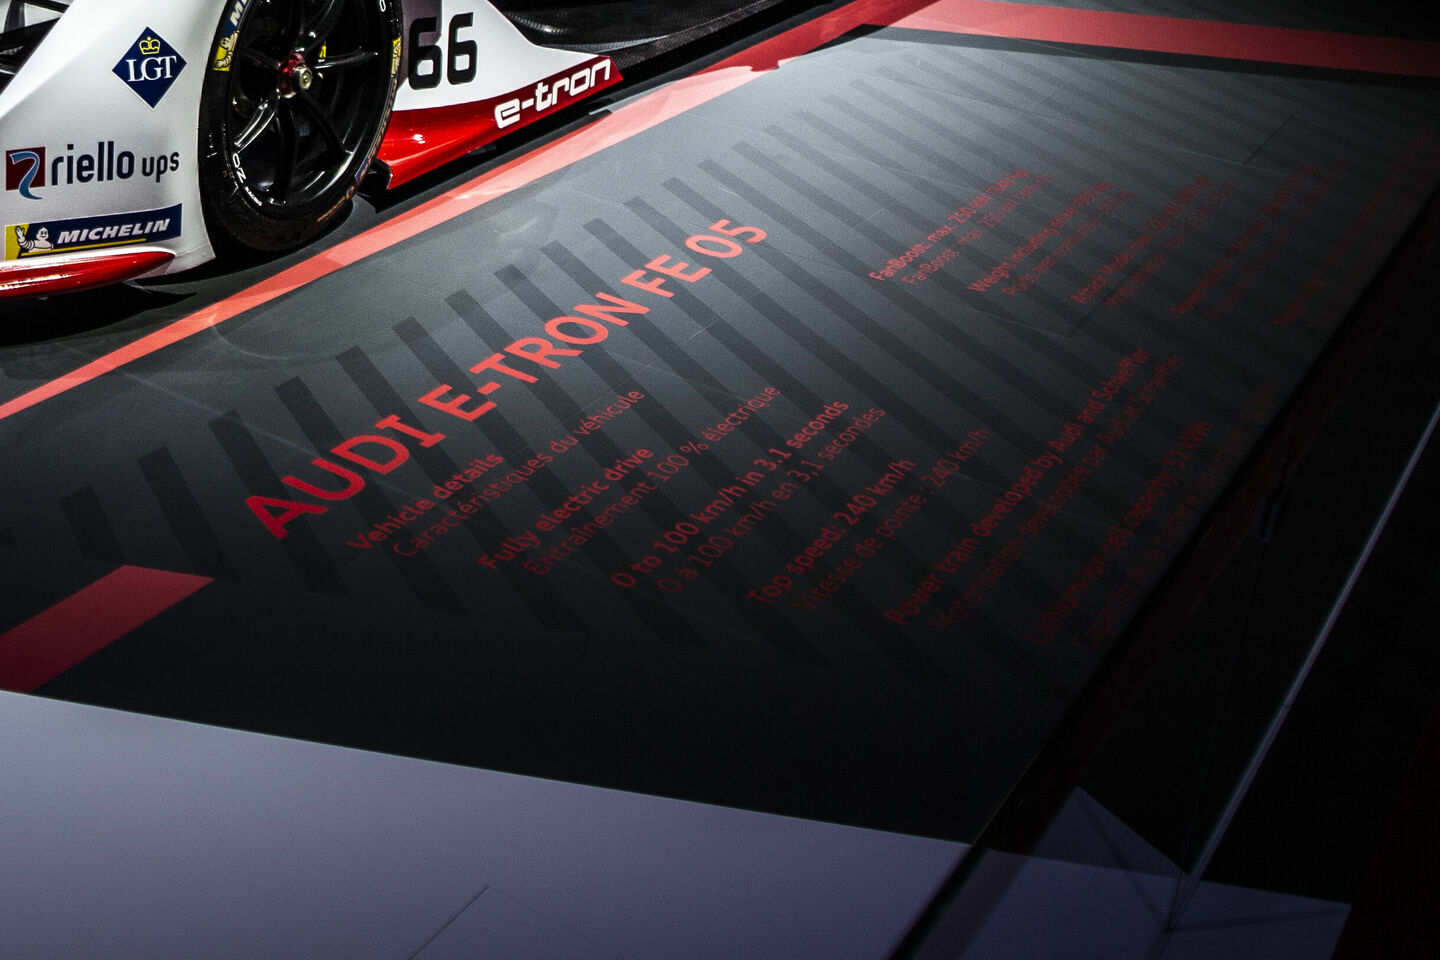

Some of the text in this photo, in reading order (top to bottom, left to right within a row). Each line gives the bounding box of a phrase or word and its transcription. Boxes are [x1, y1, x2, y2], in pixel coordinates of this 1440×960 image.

[125, 55, 178, 83] LGT
[407, 12, 478, 91] 66
[494, 57, 612, 130] e-tron
[51, 140, 181, 186] riello ups
[57, 218, 170, 244] MICHELIN
[245, 219, 768, 540] AUDI E-TRON FE 05
[345, 454, 504, 551] Vehicle details
[392, 390, 645, 557] Caractéristiques du véhicule
[477, 447, 654, 571] Fully electric drive
[523, 386, 781, 577] Entraînement 100 % électrique
[610, 400, 849, 589] 0 to 100 km/h in 3.1 seconds
[656, 407, 886, 593] 0 à 100 km/h en 3,1 secondes
[745, 459, 917, 604] Top speed: 240 km/h
[787, 557, 863, 611] Vitesse
[854, 536, 884, 560] de
[875, 492, 928, 540] pointe
[920, 458, 961, 489] 240
[953, 427, 992, 462] km/h
[883, 347, 1151, 626] Power train developed by Audi and Schaeffler
